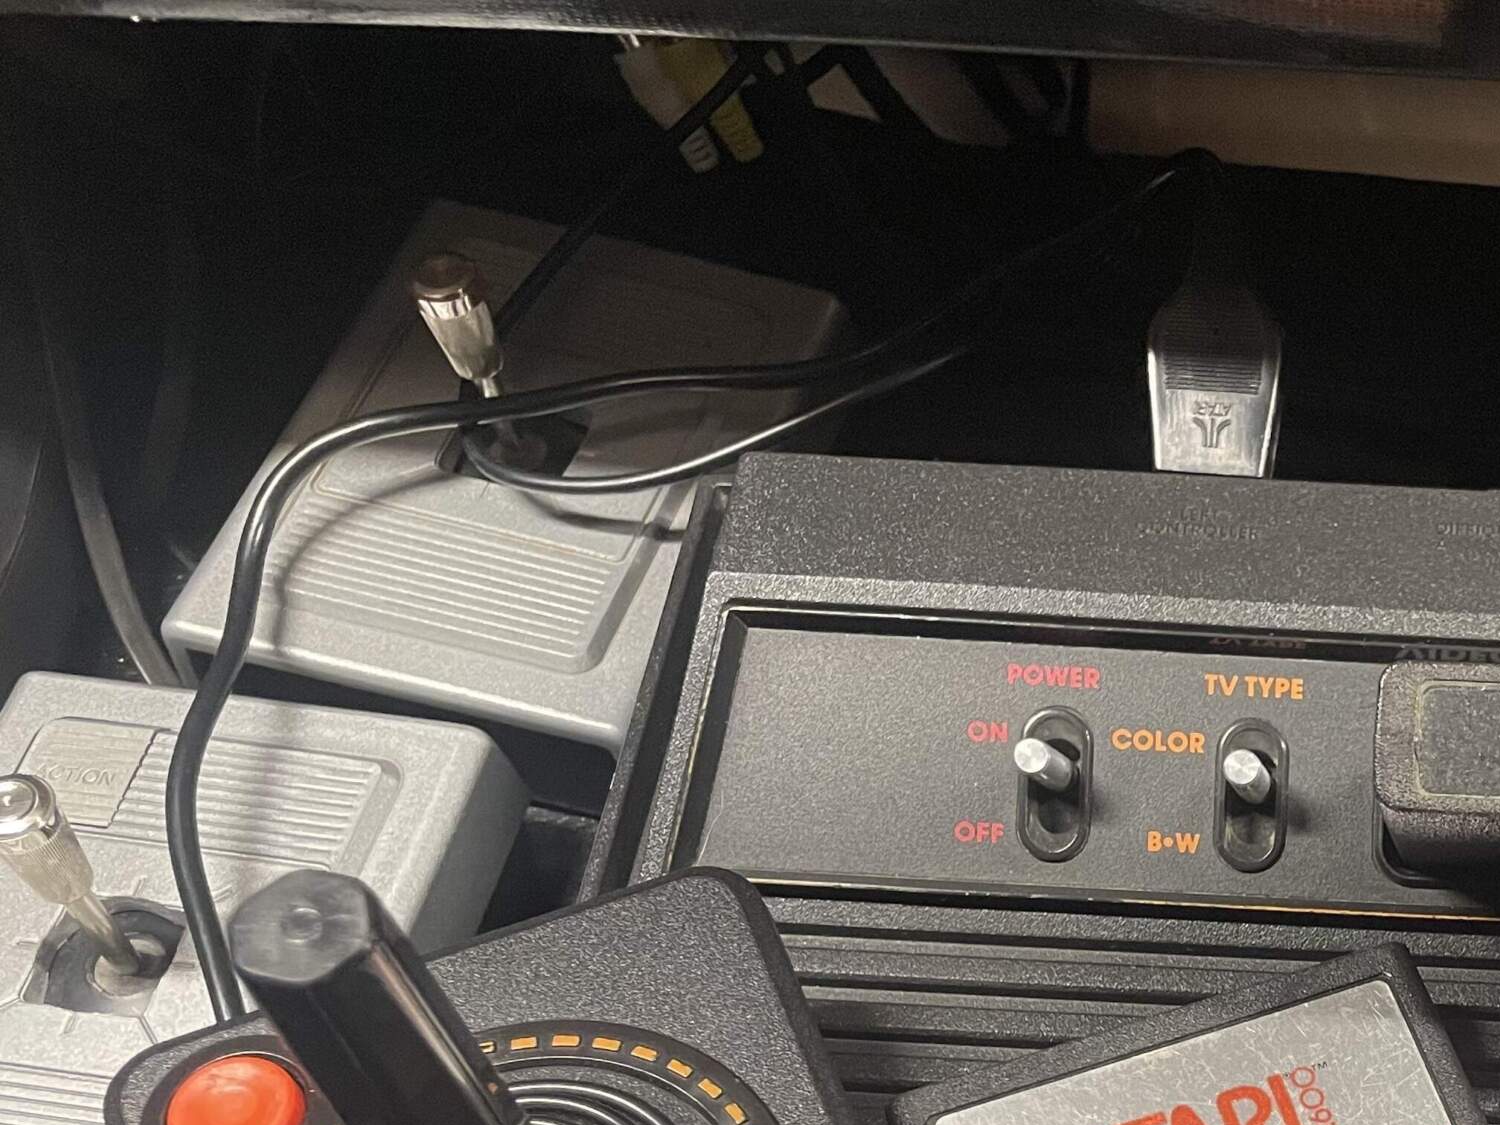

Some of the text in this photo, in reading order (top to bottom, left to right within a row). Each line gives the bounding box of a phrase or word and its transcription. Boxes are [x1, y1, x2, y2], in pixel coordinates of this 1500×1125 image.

[1007, 662, 1099, 688] POWER
[1204, 673, 1304, 699] TV TYPE
[966, 721, 1008, 742] ON
[1112, 729, 1205, 754] COLOR
[954, 820, 1004, 843] OFF
